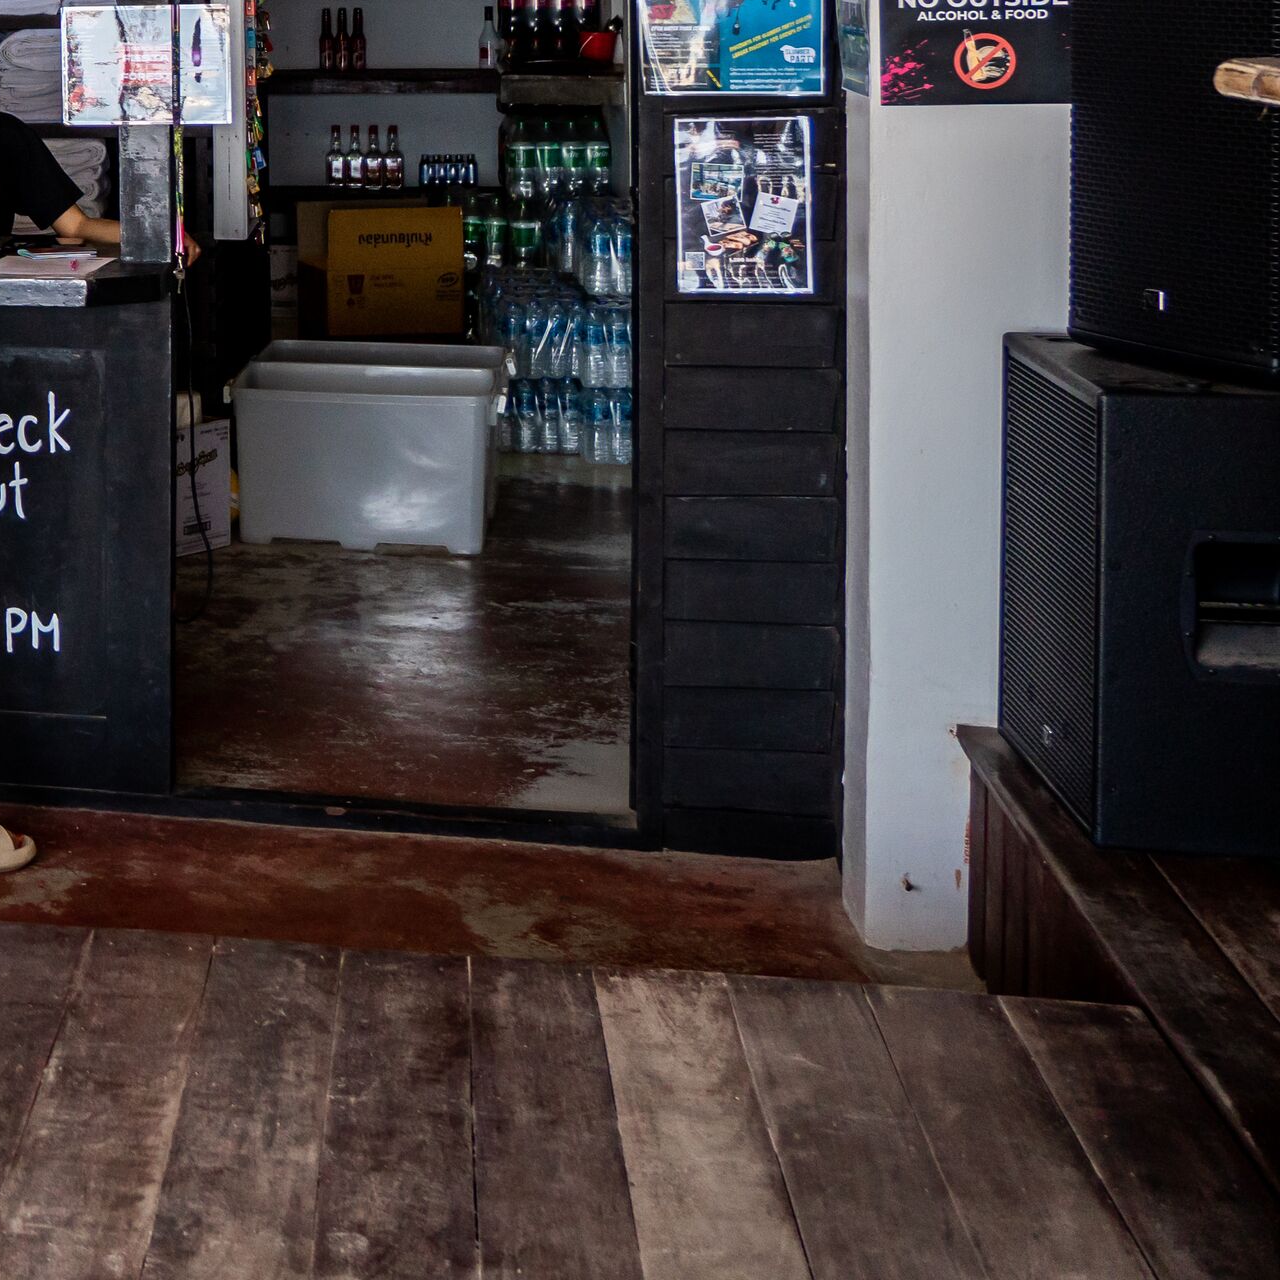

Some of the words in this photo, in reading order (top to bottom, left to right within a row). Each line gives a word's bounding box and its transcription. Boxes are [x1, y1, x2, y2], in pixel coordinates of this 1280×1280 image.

[916, 10, 988, 21] ALCOHOL
[990, 9, 1002, 20] &
[1005, 9, 1049, 20] FOOD
[6, 606, 61, 653] PM
